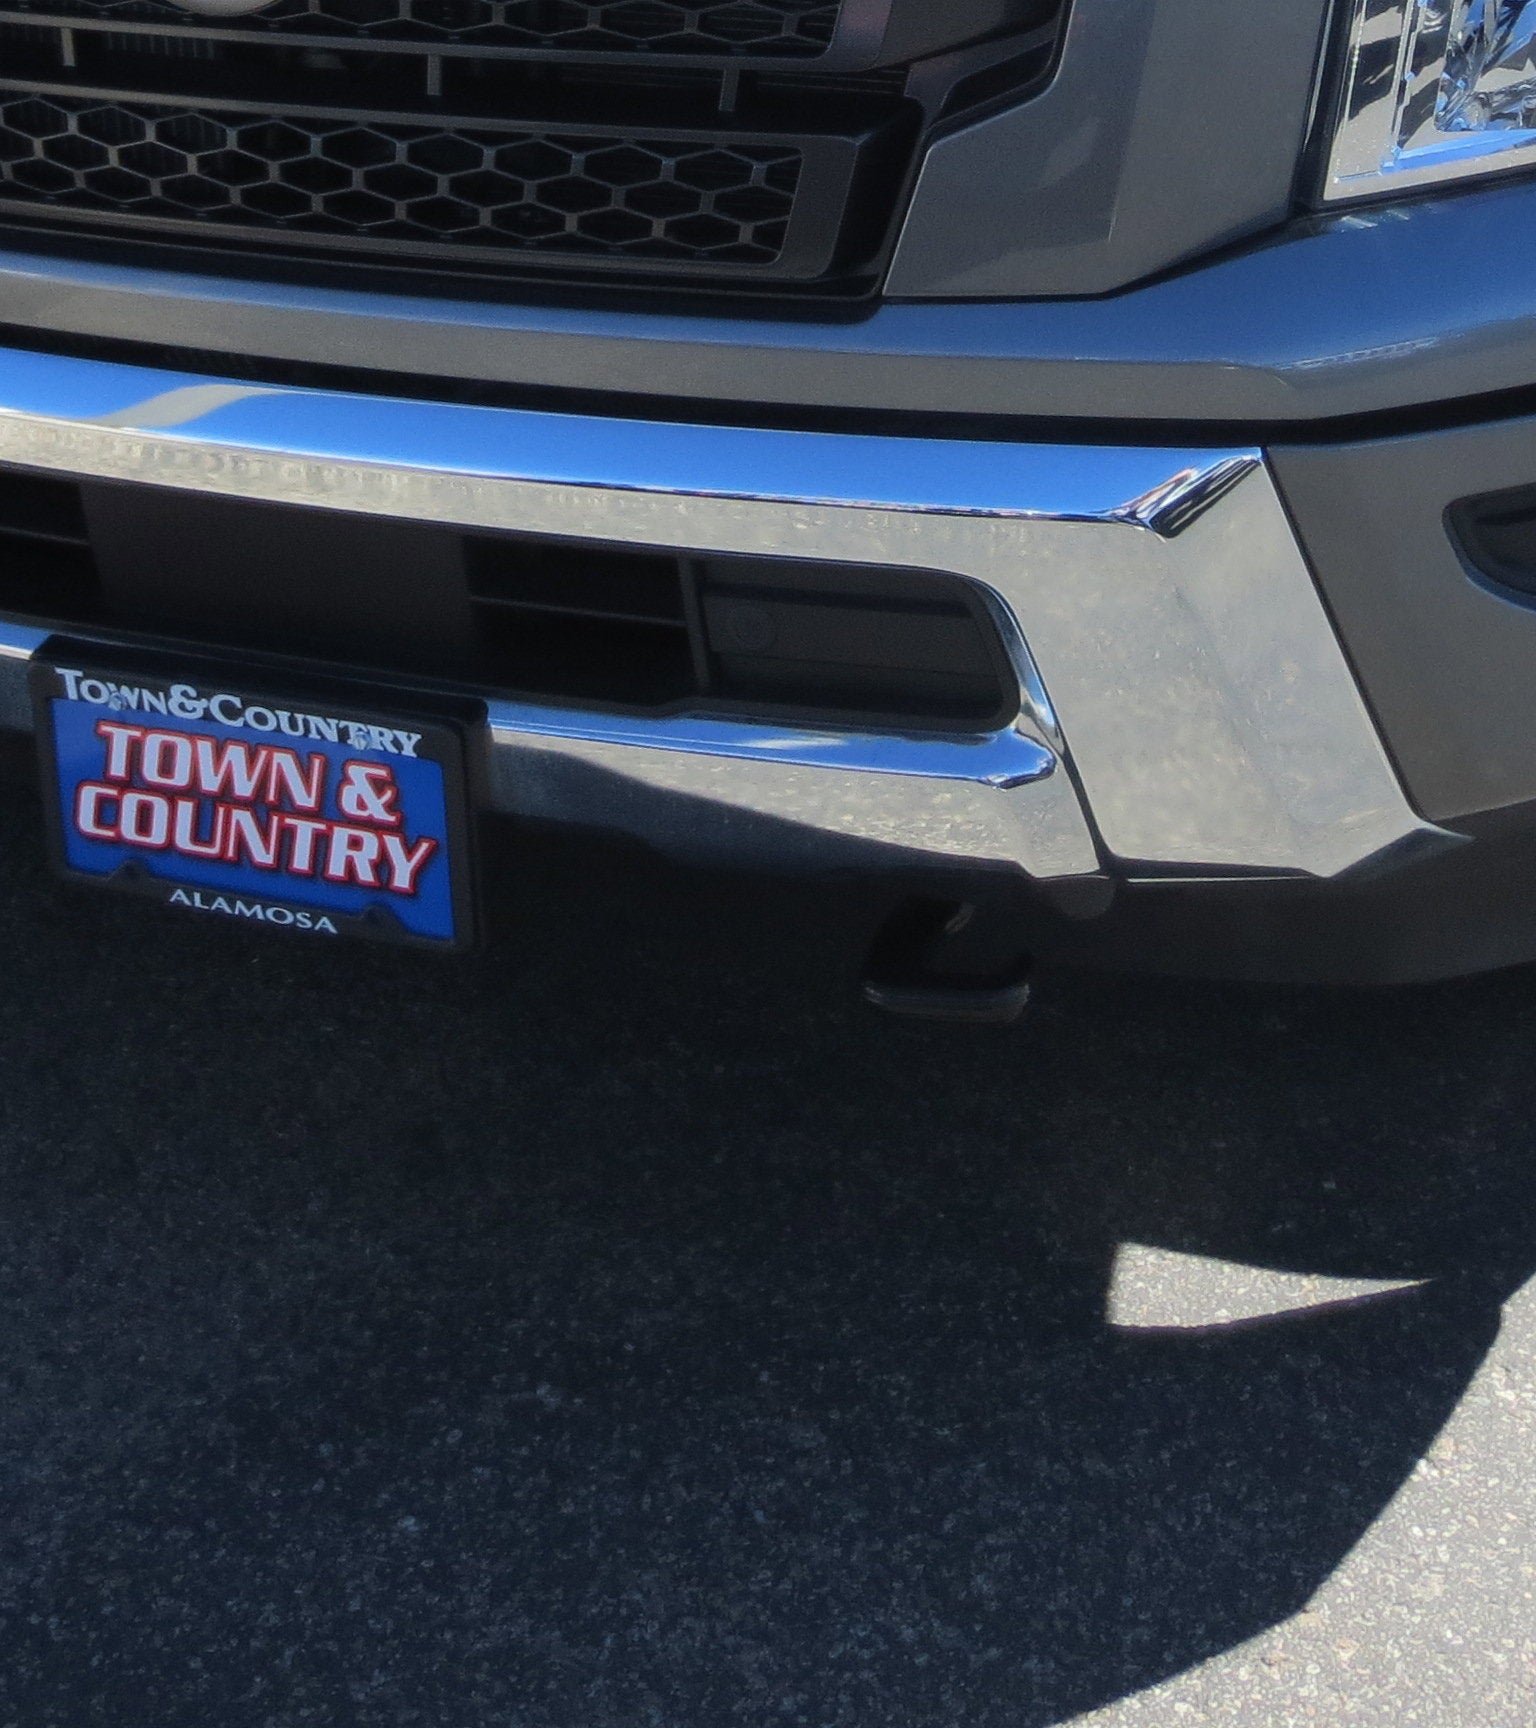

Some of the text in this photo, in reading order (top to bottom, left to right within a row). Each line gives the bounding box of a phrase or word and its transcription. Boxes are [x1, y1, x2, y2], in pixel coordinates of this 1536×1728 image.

[96, 721, 403, 827] TOWN &
[75, 783, 435, 895] COUNTRY
[169, 889, 338, 934] ALAMOSA
